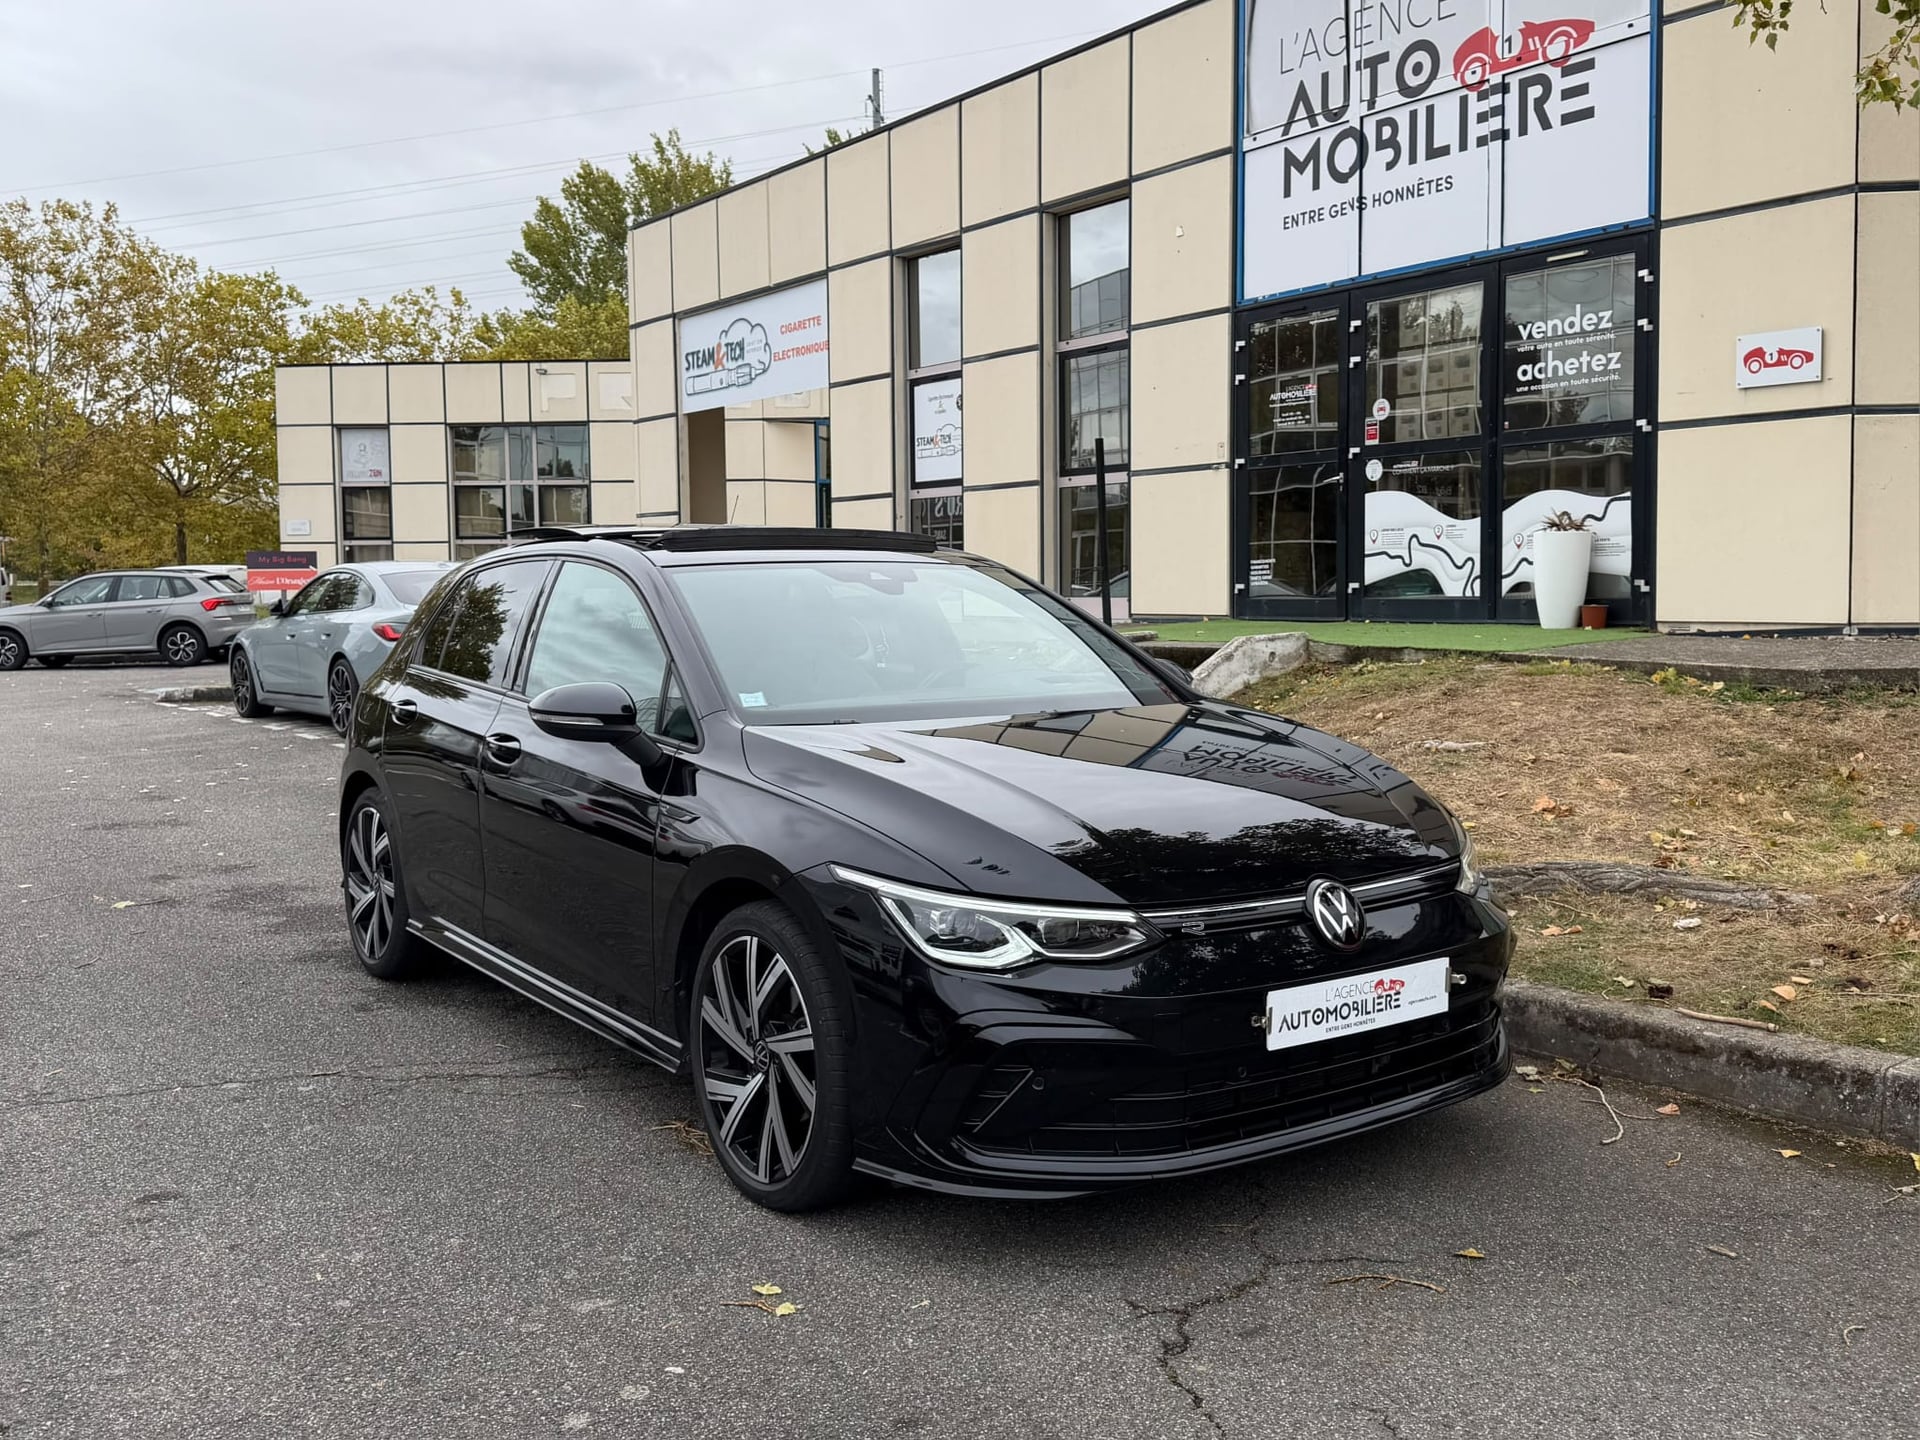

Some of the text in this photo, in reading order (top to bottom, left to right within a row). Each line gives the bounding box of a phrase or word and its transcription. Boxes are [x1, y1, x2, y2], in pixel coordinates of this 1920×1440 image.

[1280, 0, 1457, 75] L'AGENCE
[1281, 38, 1441, 137] AUTO
[1283, 175, 1454, 230] ENTRE GENS HONNÊTES
[780, 315, 822, 335] CIGARETTE
[1518, 303, 1613, 340] vendez
[773, 340, 830, 362] ELECTRONIQUE
[1517, 344, 1534, 353] votre
[1565, 337, 1584, 346] toute
[1517, 350, 1622, 382] achetez
[1516, 385, 1529, 393] une
[1530, 381, 1559, 391] occasion
[1570, 377, 1589, 386] toute
[1325, 980, 1375, 1002] L'AGENCE
